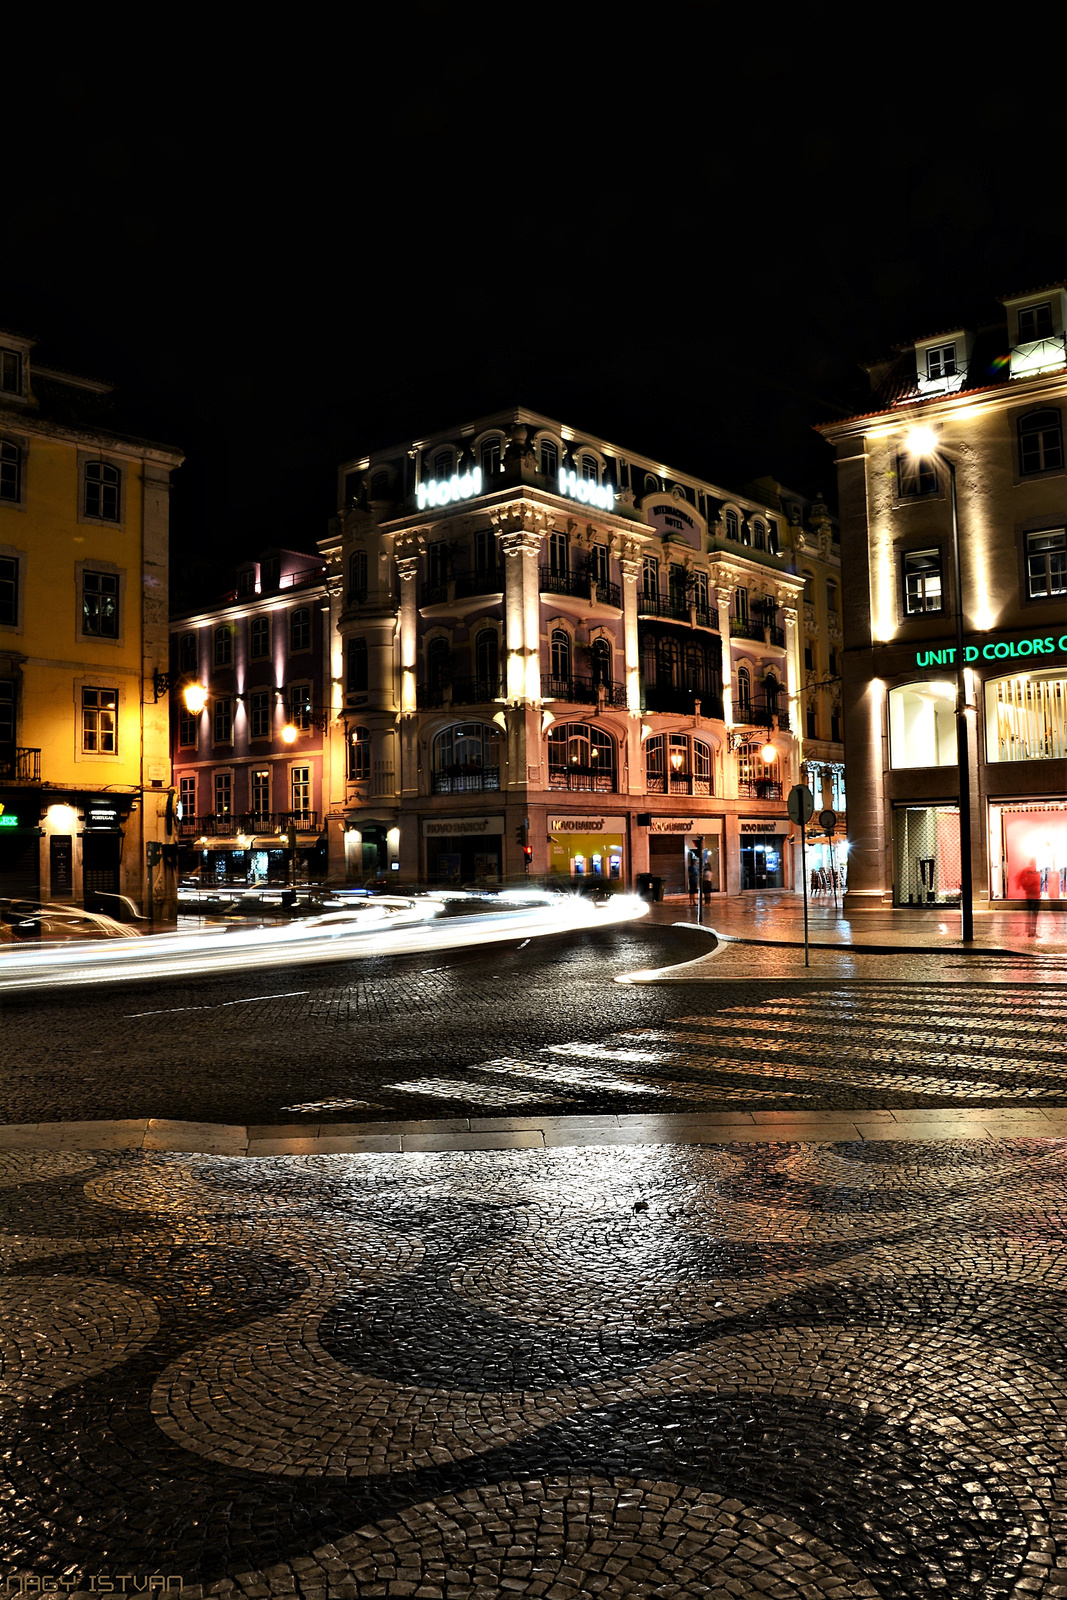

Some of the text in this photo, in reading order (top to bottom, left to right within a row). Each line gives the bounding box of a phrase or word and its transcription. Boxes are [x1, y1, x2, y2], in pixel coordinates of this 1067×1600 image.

[418, 466, 482, 510] Hotel
[559, 467, 614, 511] Hotel
[665, 516, 685, 530] HOTEL
[983, 637, 1056, 660] COLORS
[427, 821, 486, 834] NOVO BANCO
[551, 820, 603, 831] NOVO BANCO
[649, 821, 692, 832] NOVO BANCO
[741, 823, 775, 832] NOVO BANCO
